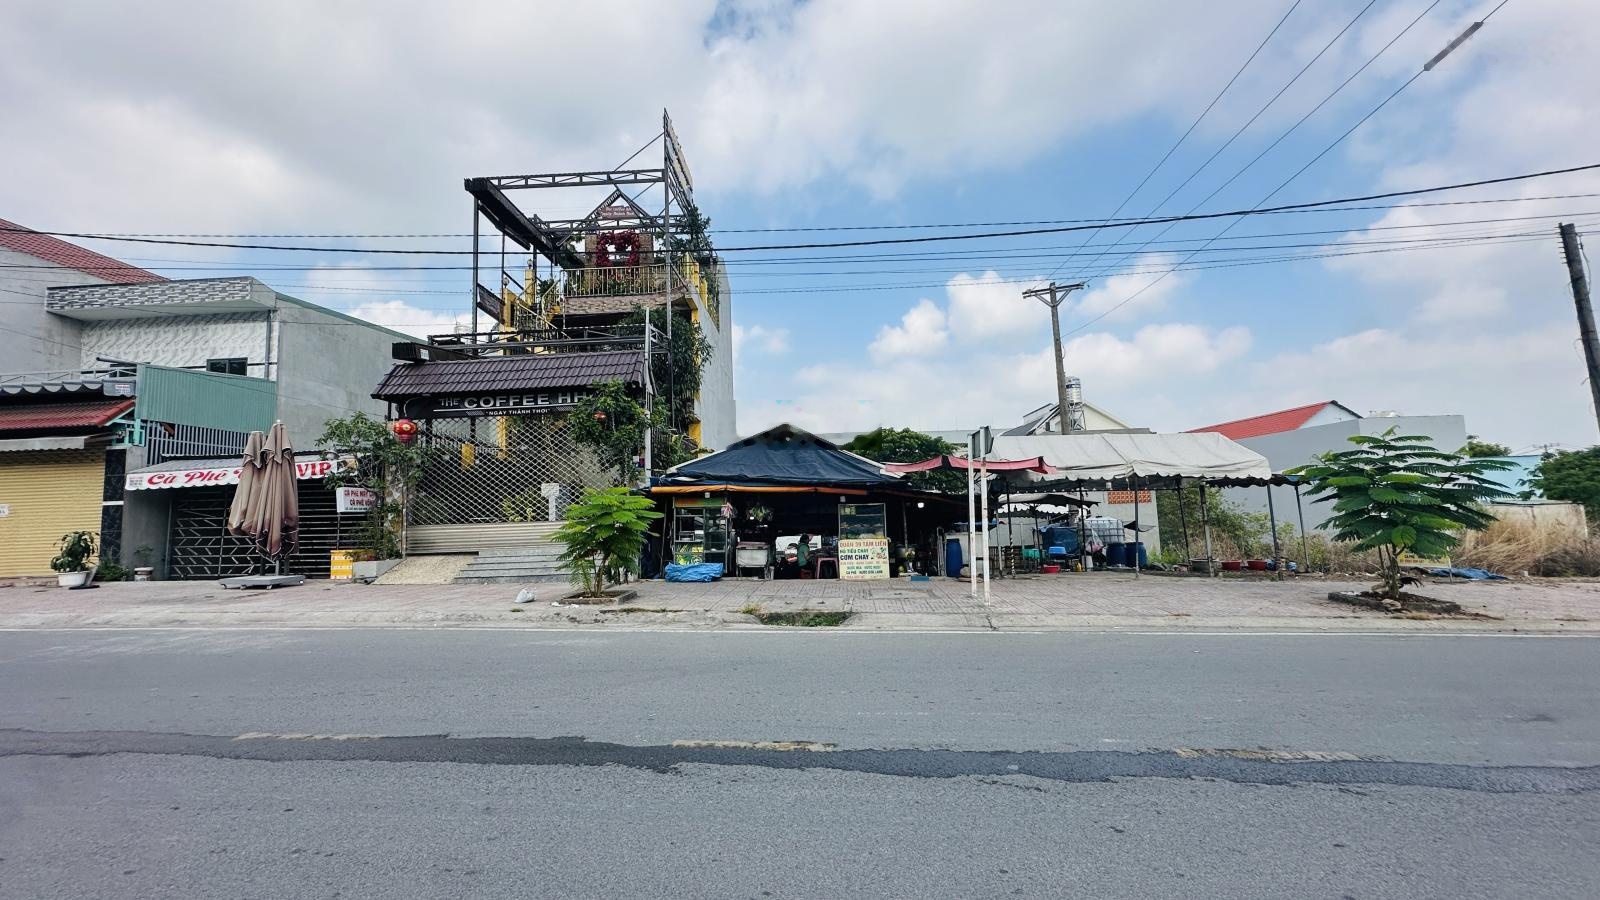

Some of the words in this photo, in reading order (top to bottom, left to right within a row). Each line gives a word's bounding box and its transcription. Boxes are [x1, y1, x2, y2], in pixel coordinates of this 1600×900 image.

[439, 397, 460, 406] THE
[464, 393, 549, 408] COFFEE
[147, 473, 177, 485] Cà
[184, 468, 227, 484] Phê
[296, 461, 332, 477] VIP
